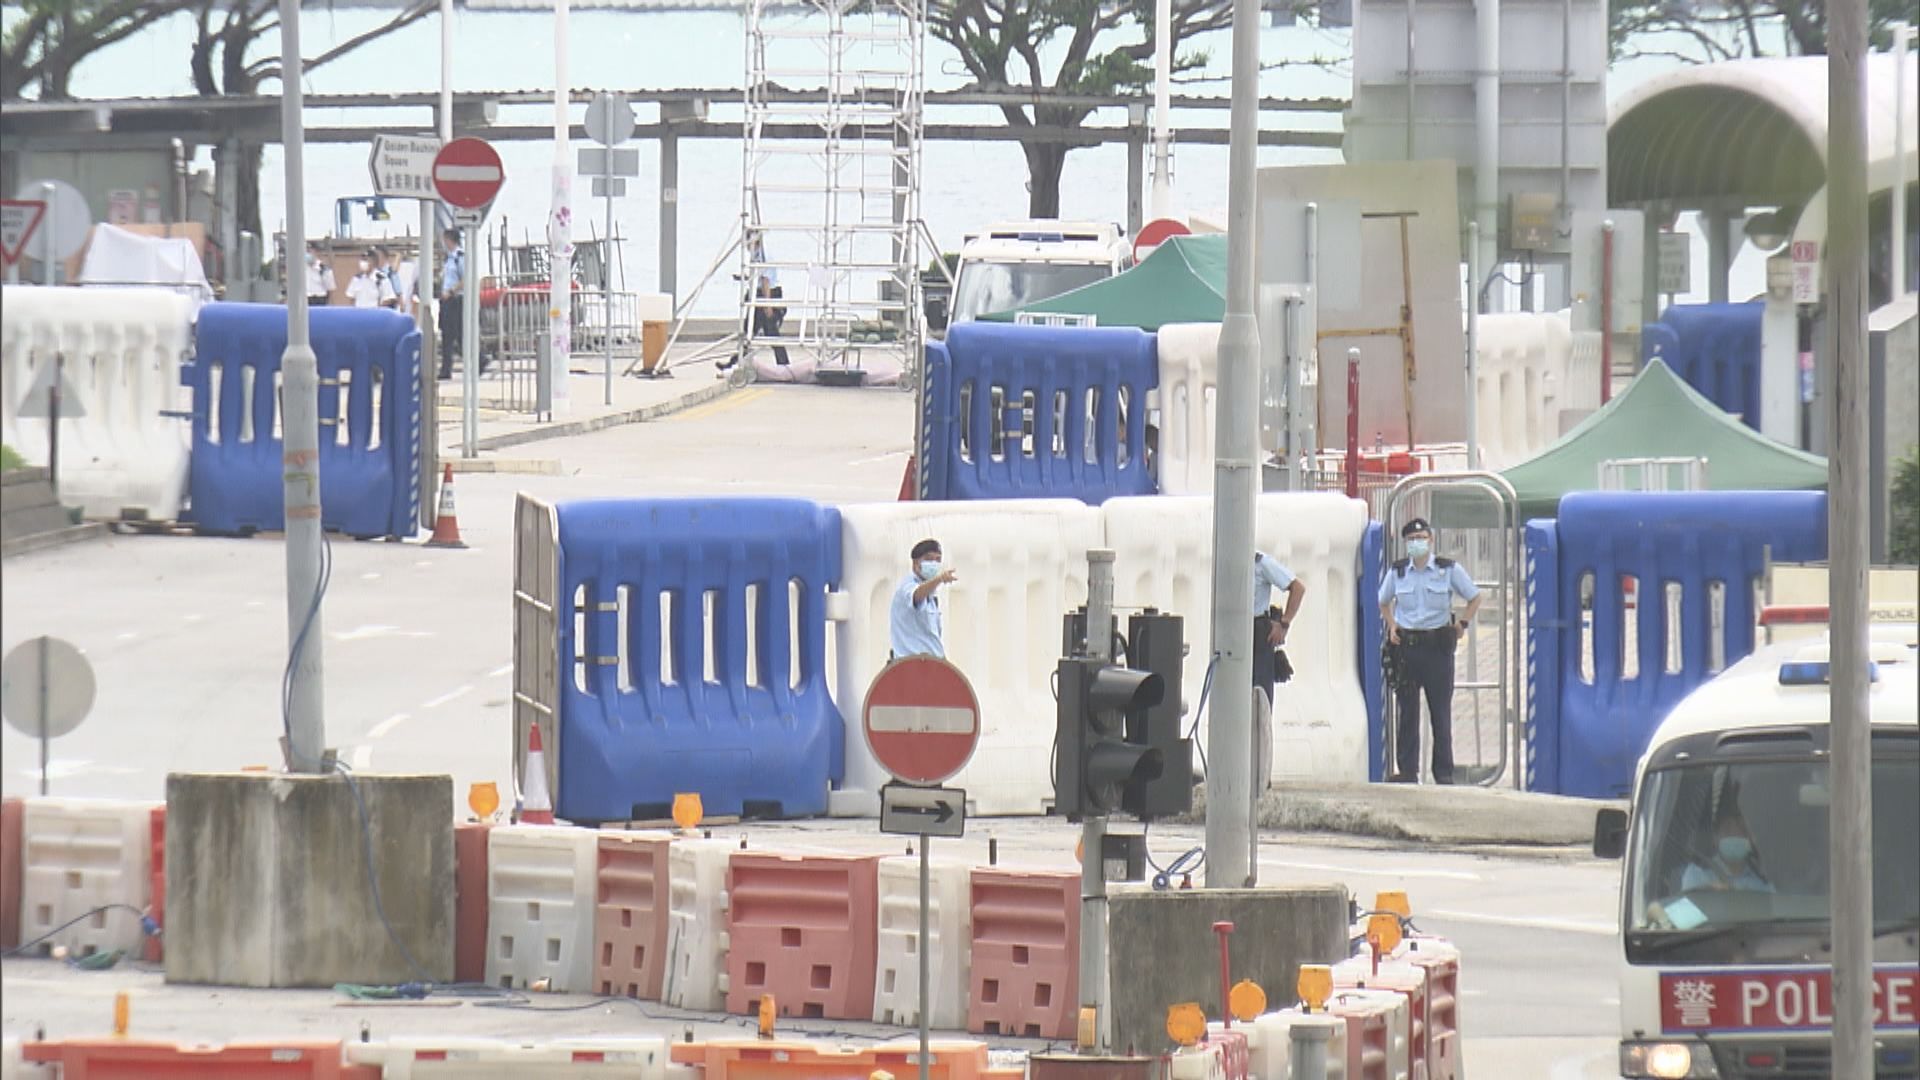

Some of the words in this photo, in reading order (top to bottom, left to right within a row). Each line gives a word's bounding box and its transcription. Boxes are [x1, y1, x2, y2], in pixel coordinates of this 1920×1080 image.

[384, 141, 408, 152] Golden
[384, 154, 409, 167] Square
[1674, 980, 1717, 1026] 警
[1742, 978, 1914, 1026] POLE
